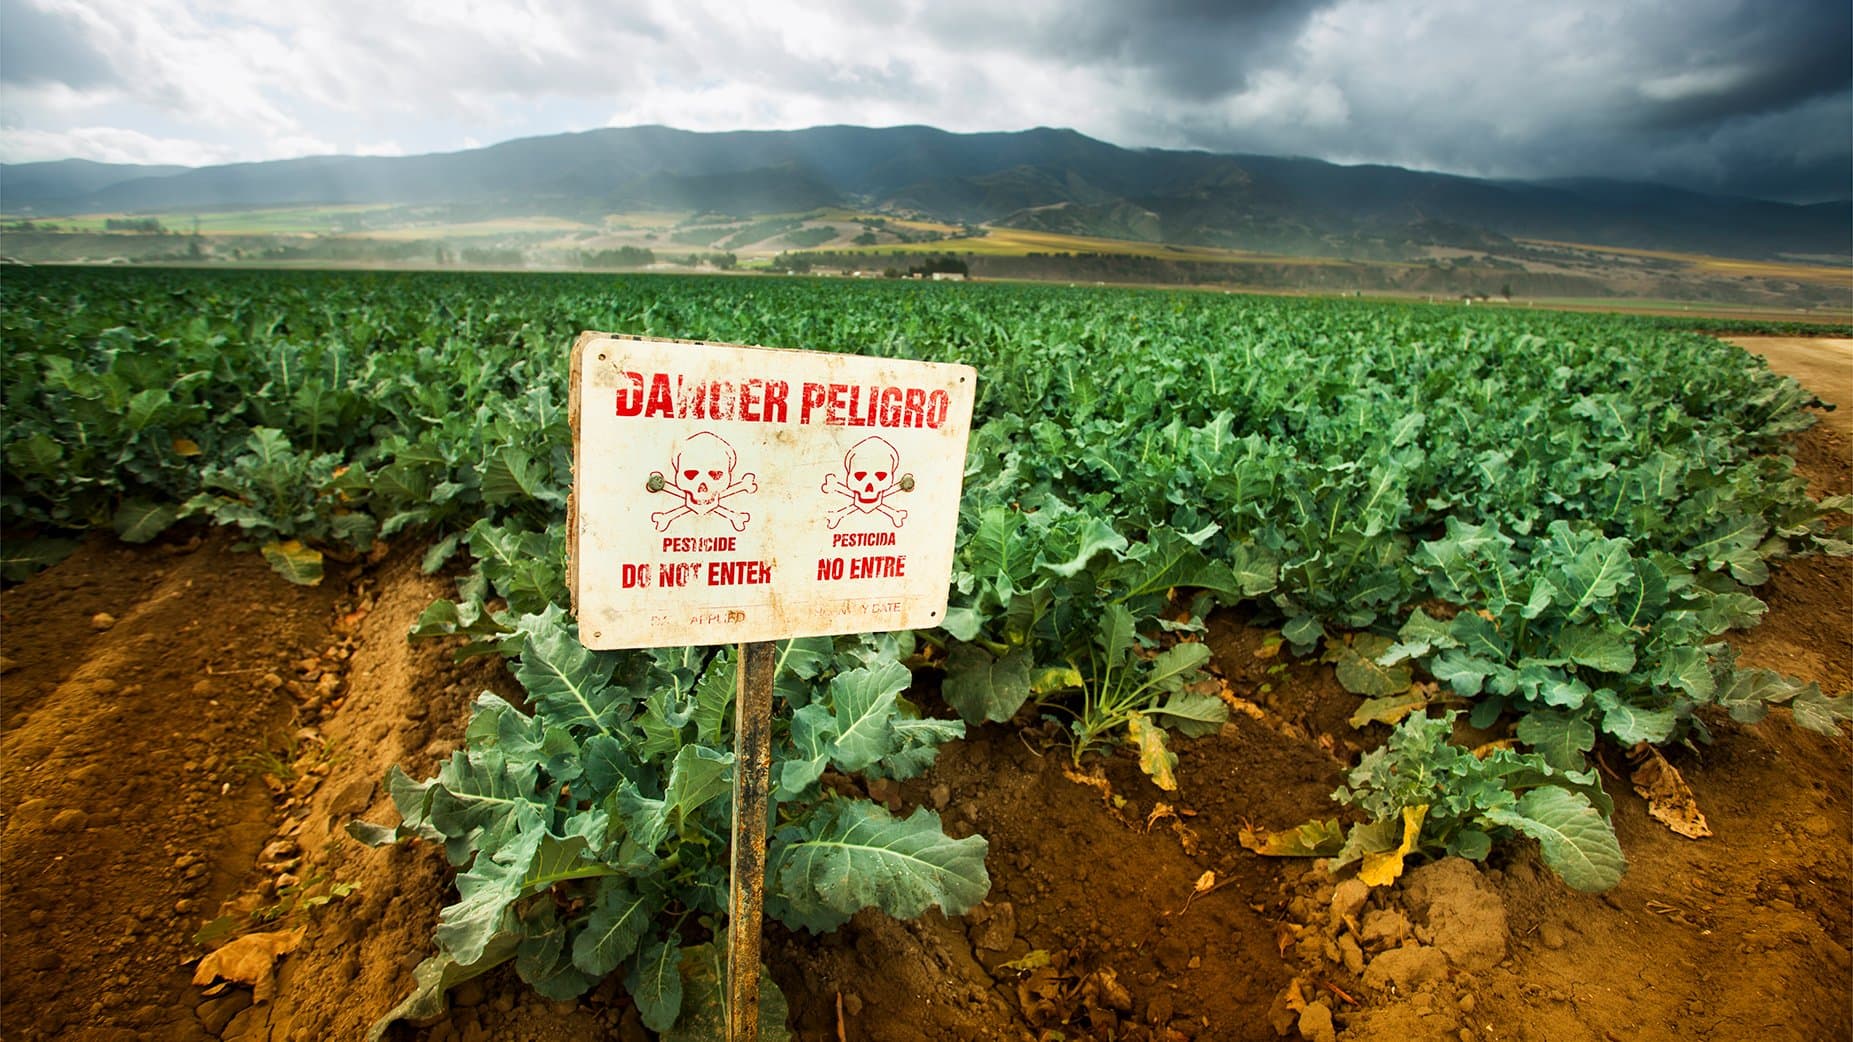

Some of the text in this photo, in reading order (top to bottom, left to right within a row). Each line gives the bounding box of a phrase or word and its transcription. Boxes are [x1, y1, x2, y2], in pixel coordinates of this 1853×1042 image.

[615, 371, 949, 429] DANGER PELIGRO
[662, 537, 736, 553] PESTICIDE
[832, 532, 896, 548] PESTICIDA
[622, 560, 773, 589] DO NOT ENTER
[817, 555, 907, 581] NO ENTRE
